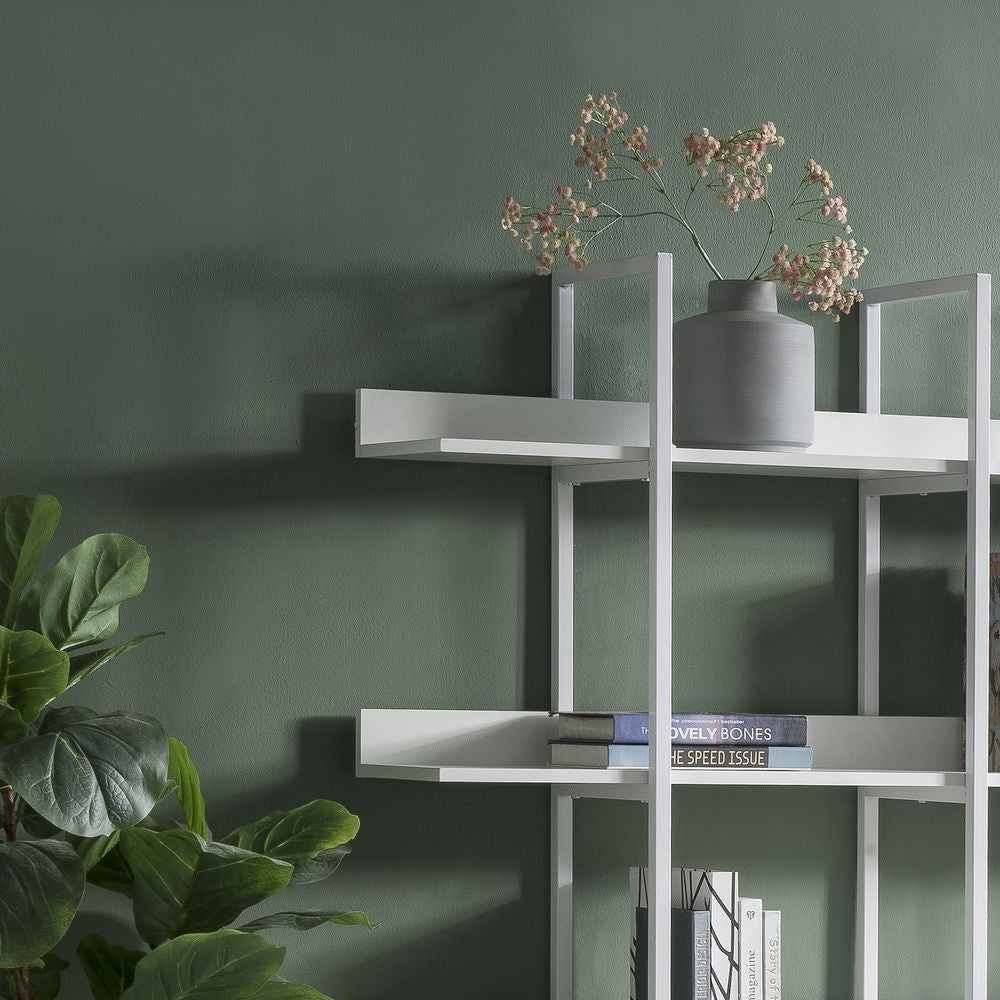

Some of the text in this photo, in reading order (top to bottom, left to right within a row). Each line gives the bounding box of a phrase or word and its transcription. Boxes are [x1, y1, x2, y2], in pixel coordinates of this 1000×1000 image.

[641, 726, 772, 741] TH OVELY BONES
[671, 750, 765, 765] HE SPEED ISSUE
[767, 939, 778, 975] Story
[770, 978, 779, 991] of
